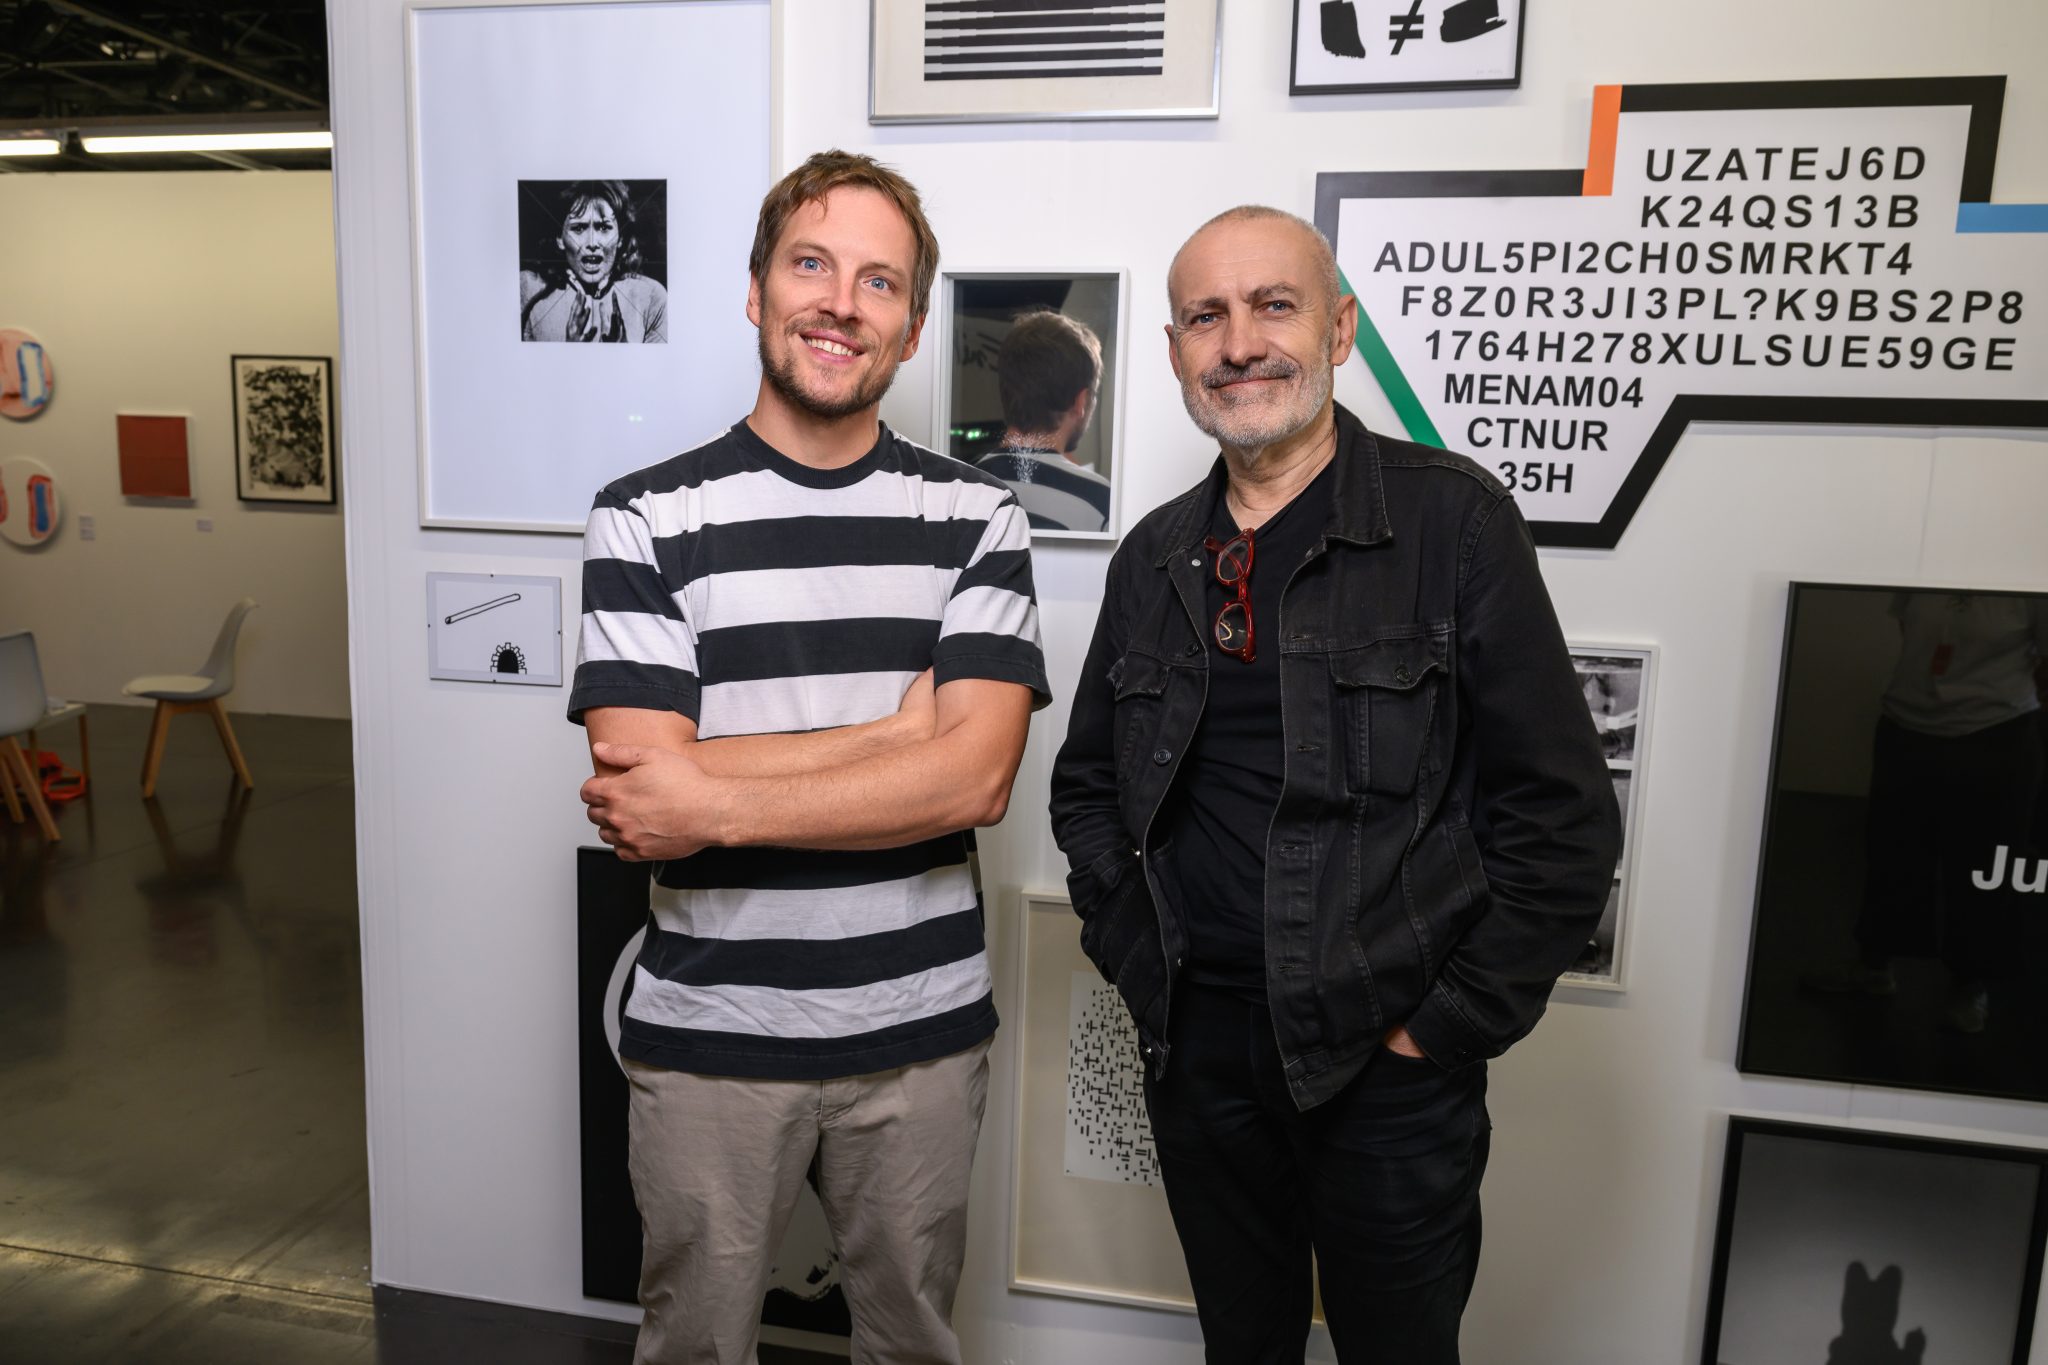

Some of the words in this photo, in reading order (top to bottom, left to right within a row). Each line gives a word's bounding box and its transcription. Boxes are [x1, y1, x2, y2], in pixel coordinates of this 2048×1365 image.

[1646, 147, 1926, 182] UZATEJ6D
[1641, 194, 1919, 231] K24QS13B
[1425, 330, 2018, 371] 1764H278XULSUE59GE
[1444, 373, 1644, 408] MENAM04
[1467, 416, 1608, 452] CTNUR
[1498, 461, 1574, 494] 35H
[1972, 845, 2048, 893] Ju
